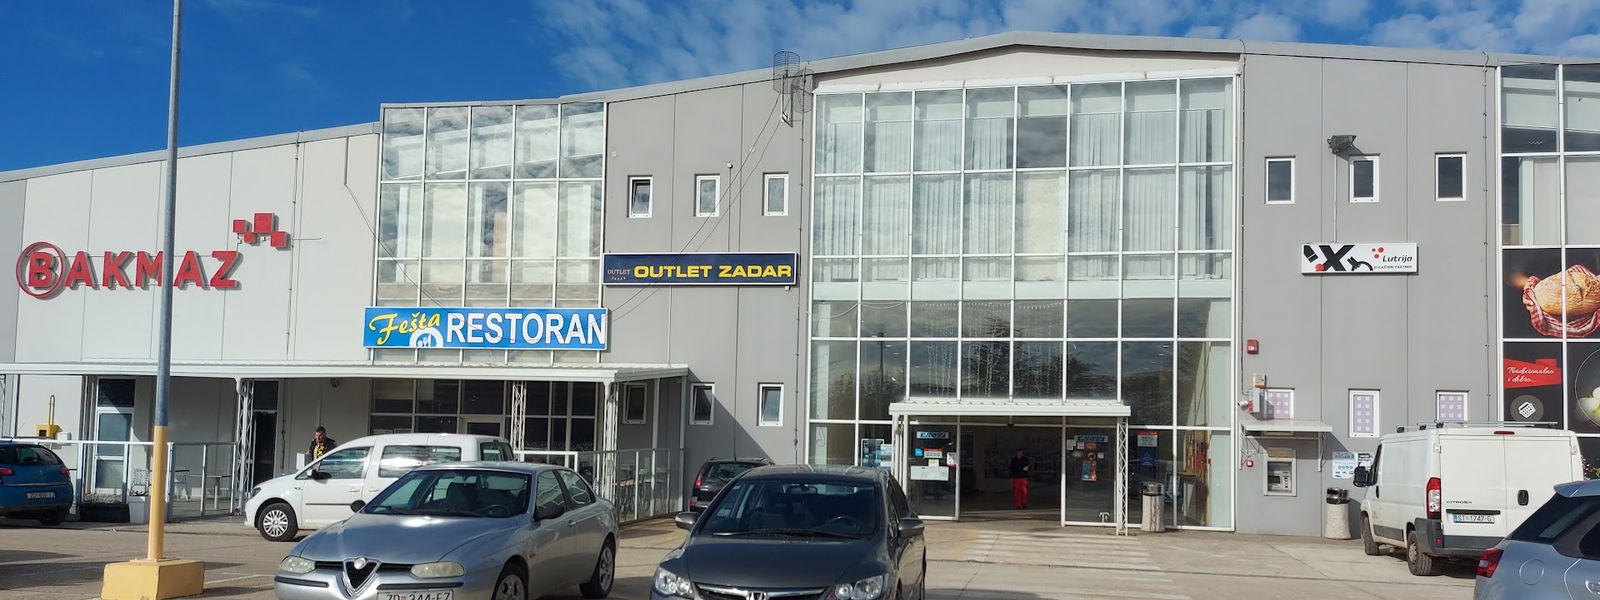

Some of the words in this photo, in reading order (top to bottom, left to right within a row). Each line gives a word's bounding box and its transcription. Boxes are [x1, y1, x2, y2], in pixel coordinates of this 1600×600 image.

[27, 250, 240, 288] BAKMAZ
[634, 265, 713, 279] OUTLET
[718, 264, 792, 278] ZADAR
[1382, 255, 1412, 263] Lutrija
[368, 312, 441, 345] Fešta
[446, 312, 606, 345] RESTORAN
